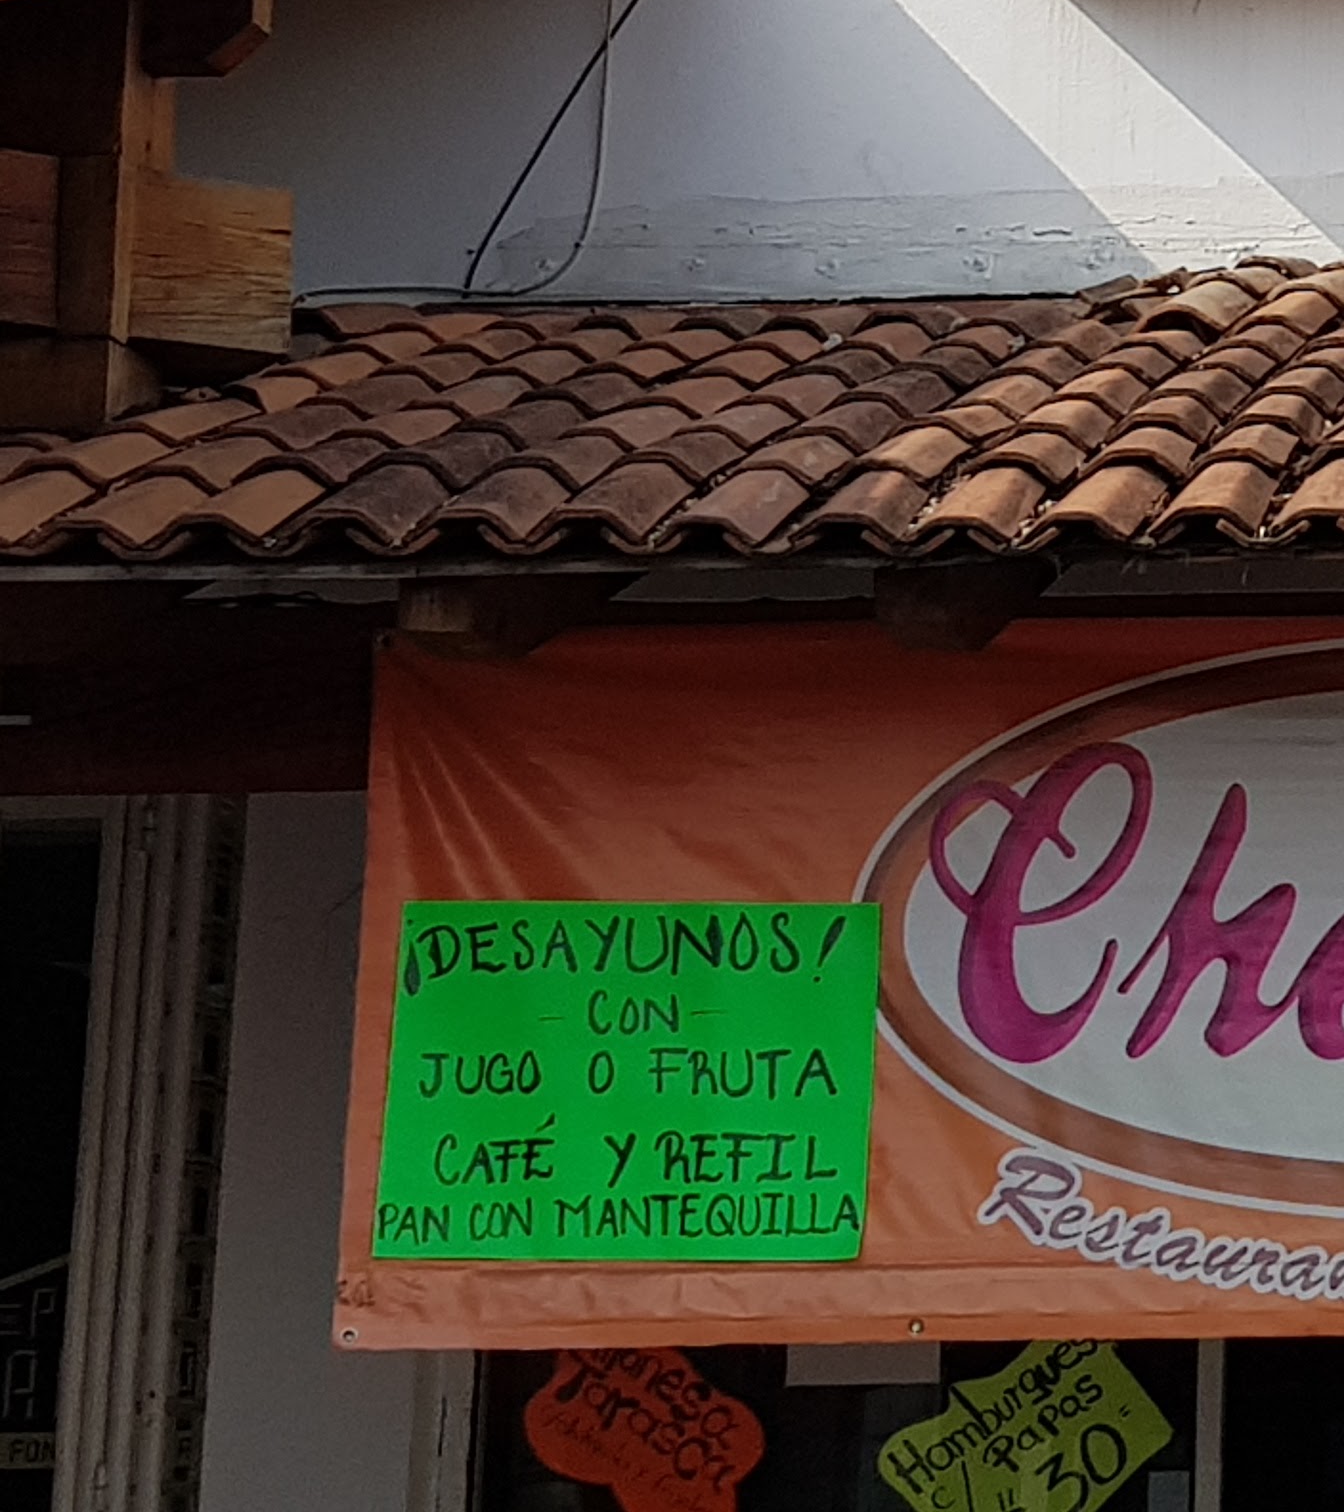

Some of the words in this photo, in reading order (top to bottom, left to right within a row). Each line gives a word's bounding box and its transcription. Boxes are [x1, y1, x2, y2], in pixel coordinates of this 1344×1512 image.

[587, 990, 680, 1035] CON
[418, 1049, 542, 1098] JUGO
[587, 1049, 616, 1095] O
[647, 1046, 838, 1100] FRUTA
[434, 1112, 557, 1186] CAFÉ
[603, 1132, 637, 1188] Y
[654, 1129, 838, 1184] REFIL
[377, 1201, 450, 1246] PAN
[468, 1198, 533, 1242] CON
[554, 1191, 862, 1240] MANTEQUILLA
[982, 1374, 1104, 1473] Papas
